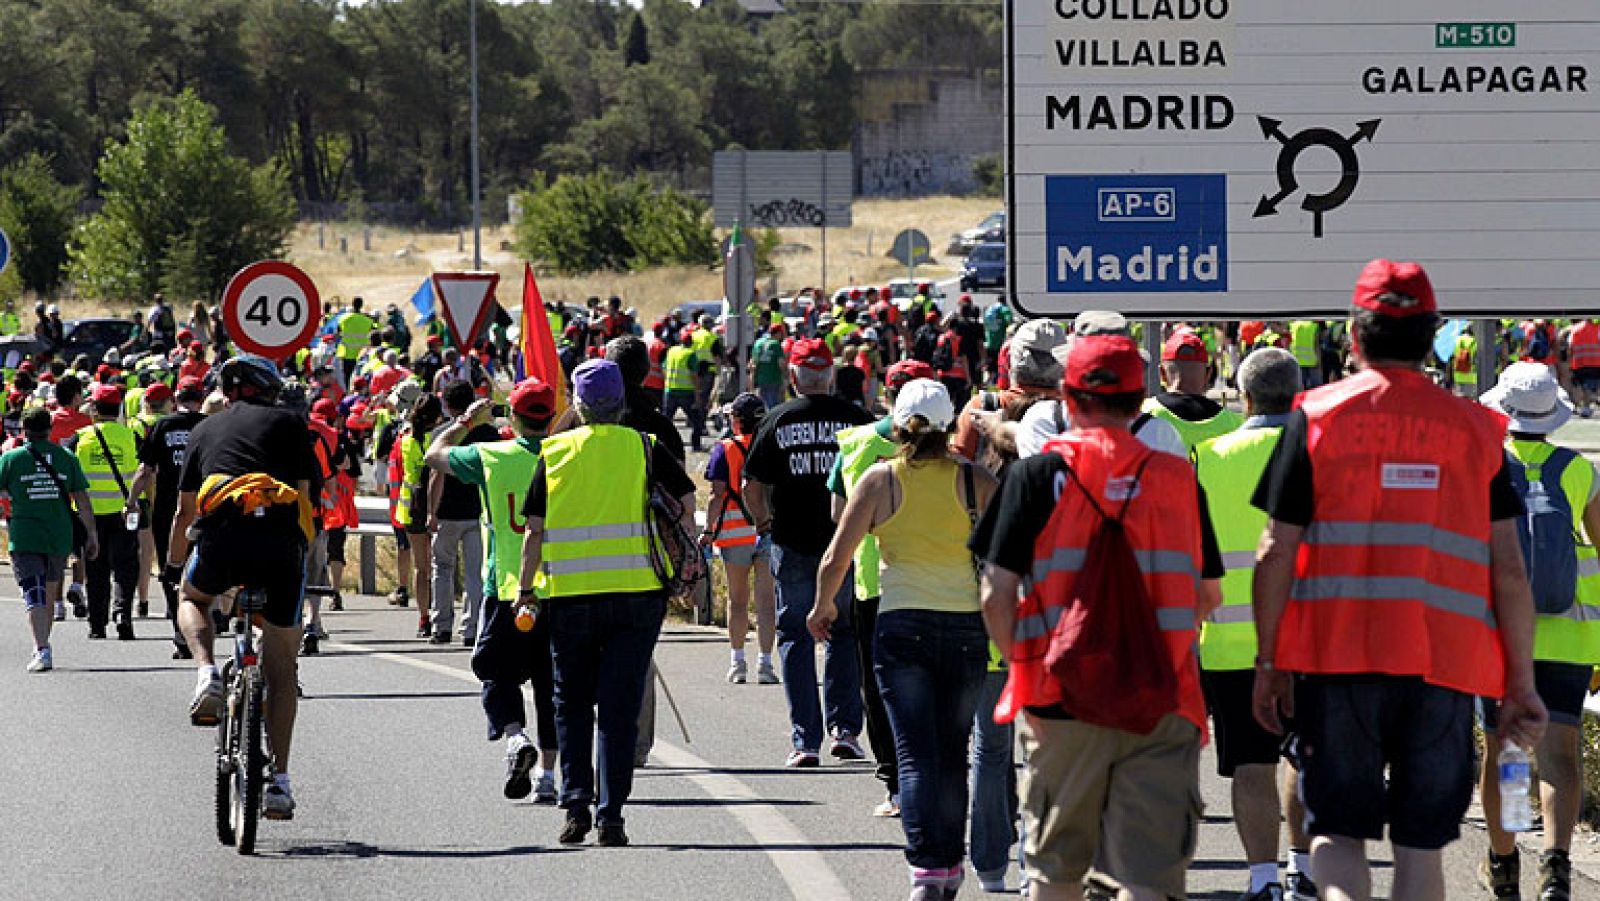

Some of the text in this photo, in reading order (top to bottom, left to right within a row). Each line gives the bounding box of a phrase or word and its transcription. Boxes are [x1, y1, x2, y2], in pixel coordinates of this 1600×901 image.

[1055, 0, 1230, 20] COLLADO
[1438, 26, 1512, 45] M-510
[1056, 39, 1226, 66] VILLALBA
[1362, 66, 1588, 94] GALAPAGAR
[1046, 95, 1235, 130] MADRID
[1104, 192, 1171, 216] AP-6
[1057, 245, 1219, 281] Madrid
[245, 294, 302, 328] 40
[789, 452, 811, 475] CON
